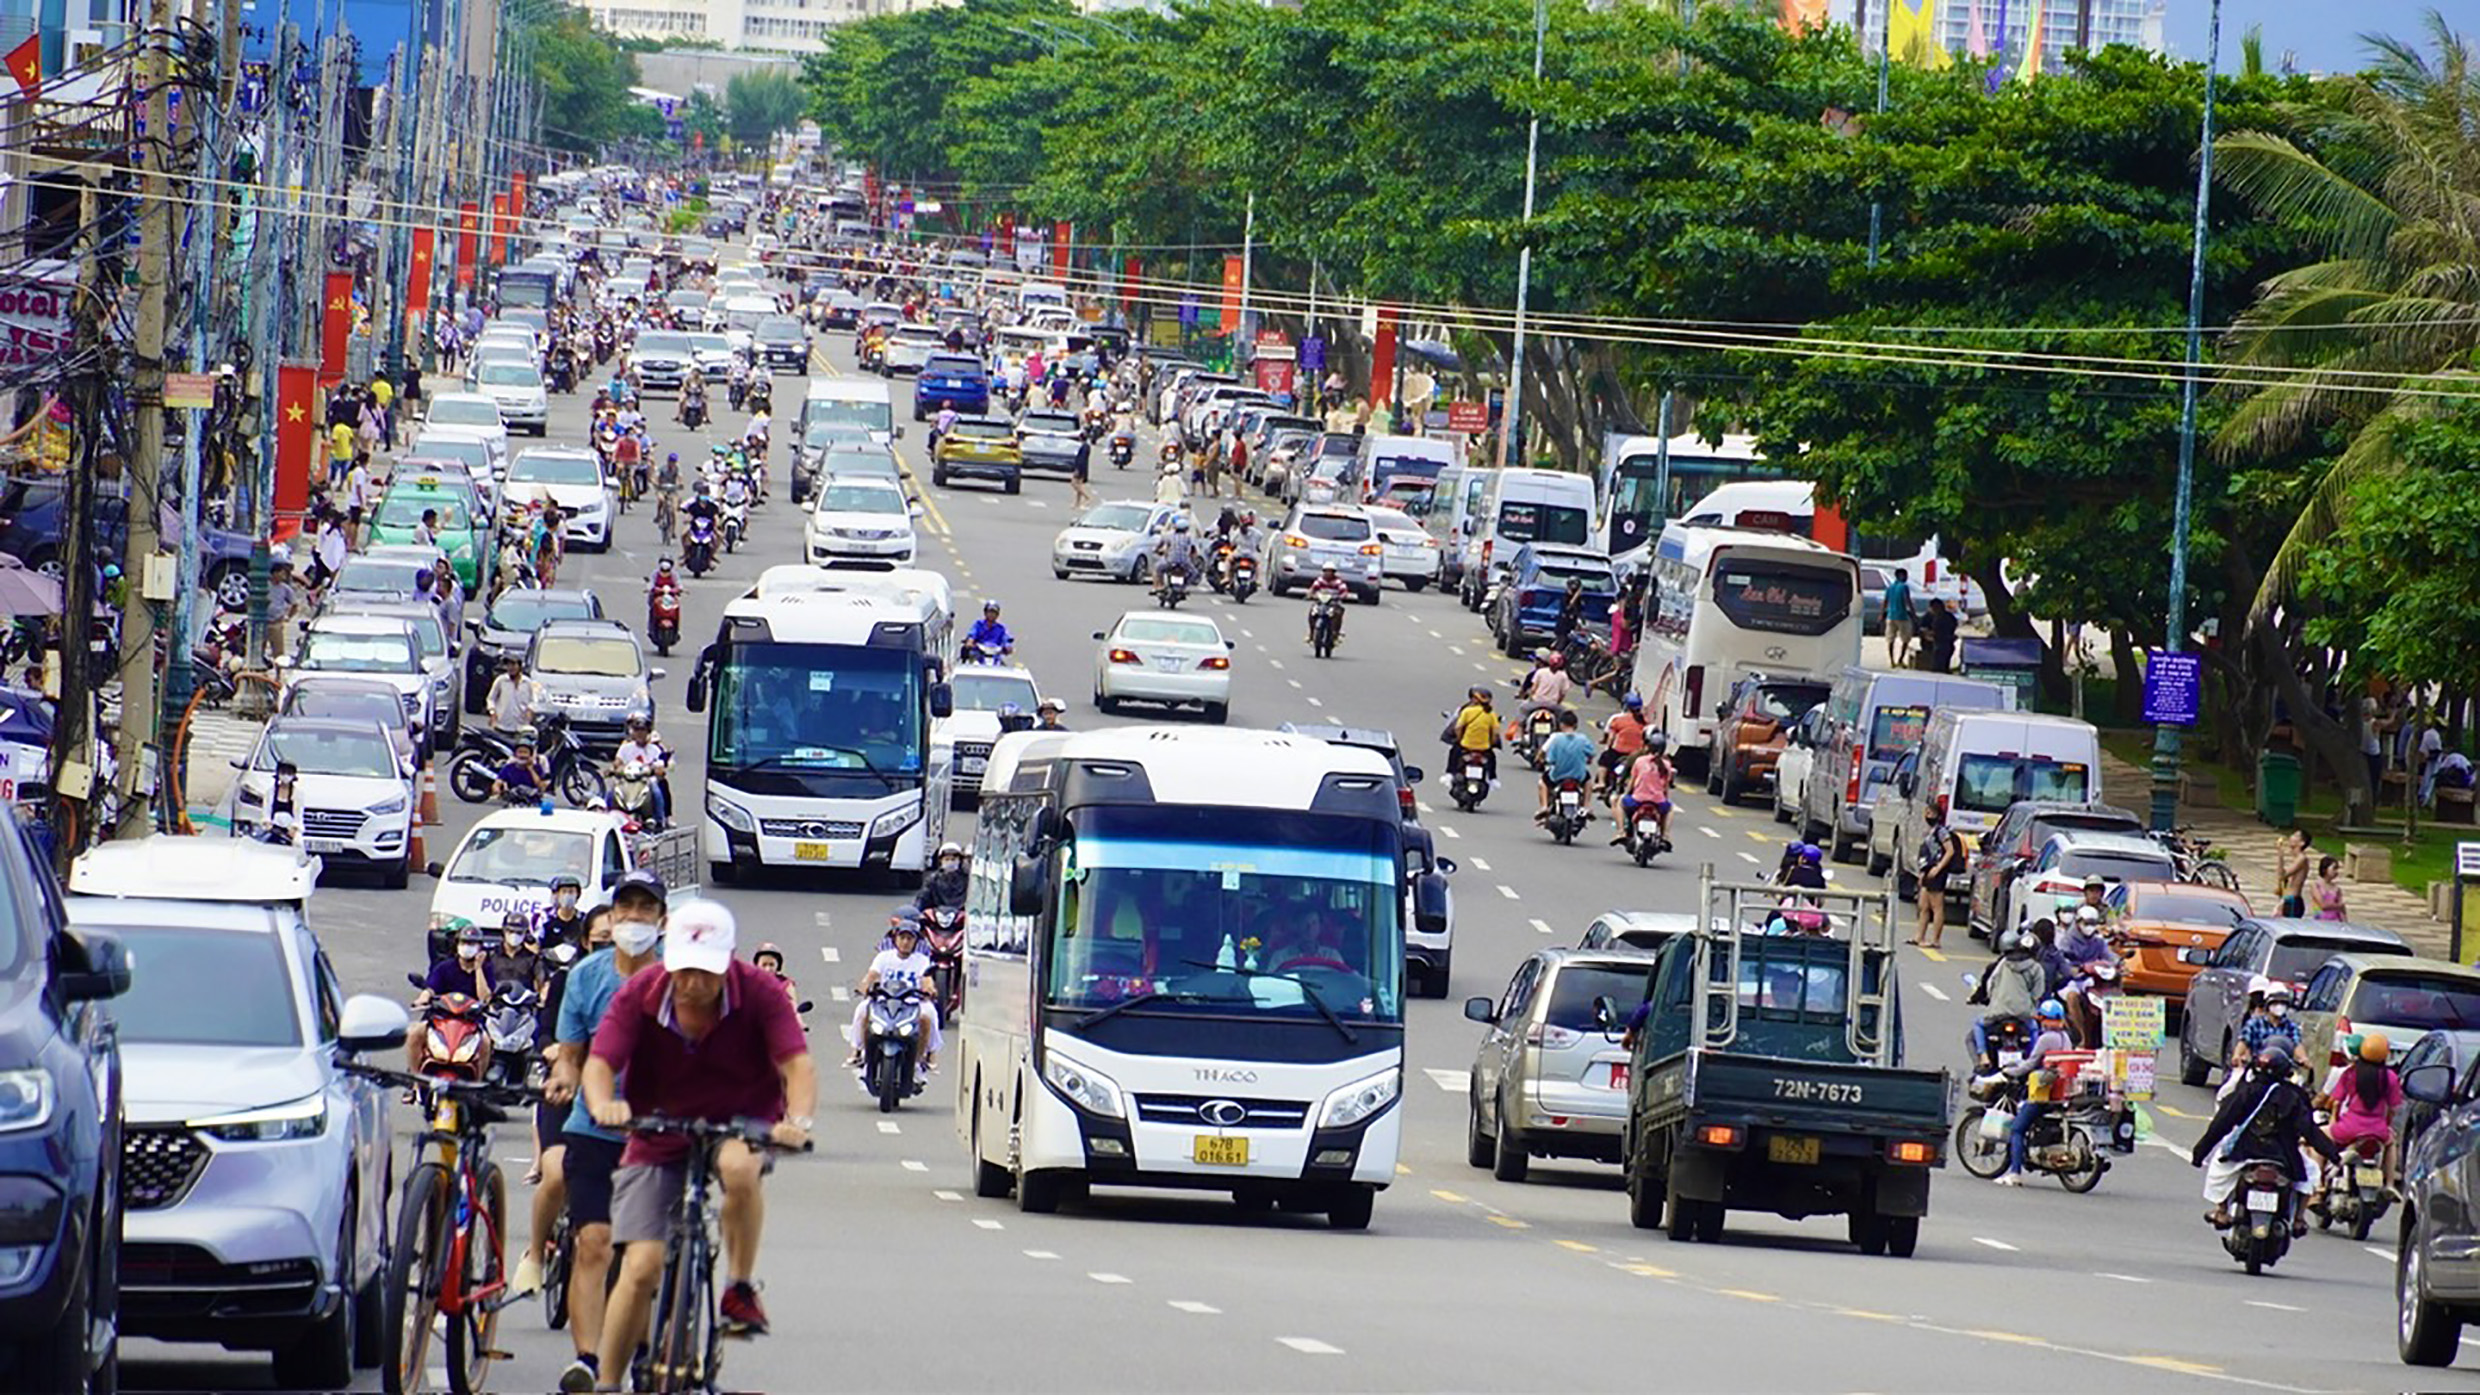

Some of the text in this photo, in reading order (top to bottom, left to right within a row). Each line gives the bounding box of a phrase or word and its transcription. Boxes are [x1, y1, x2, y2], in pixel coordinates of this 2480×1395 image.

[0, 289, 59, 318] otel
[480, 898, 542, 913] POLICE
[1193, 1068, 1258, 1083] THACO
[1209, 1138, 1233, 1150] 67B
